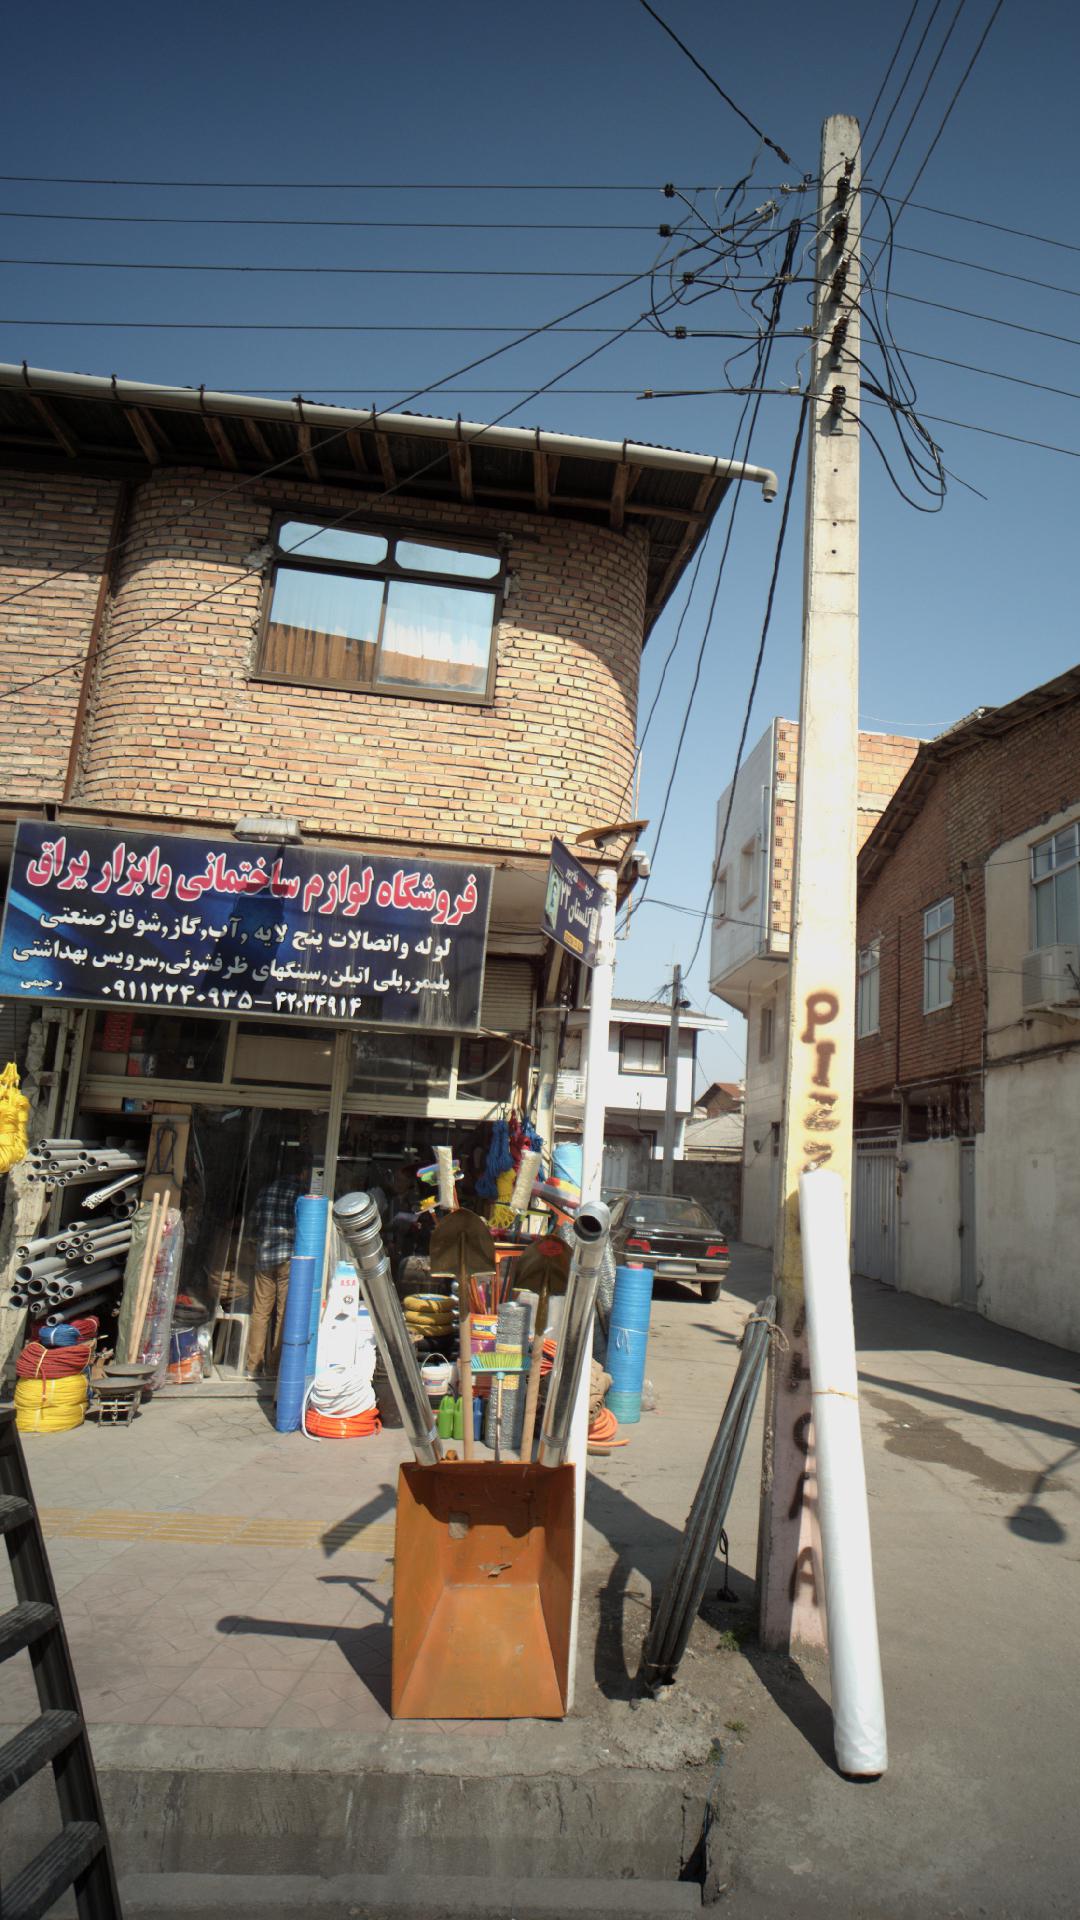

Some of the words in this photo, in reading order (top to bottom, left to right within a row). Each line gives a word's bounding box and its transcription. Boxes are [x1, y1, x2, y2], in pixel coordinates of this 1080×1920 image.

[27, 837, 90, 890] یراق
[176, 852, 300, 901] ساختمانی
[303, 865, 374, 916] لوازم
[377, 870, 478, 925] فروشگاه
[12, 939, 88, 966] بهداشتی
[292, 929, 323, 953] پنج
[414, 936, 451, 962] لوله
